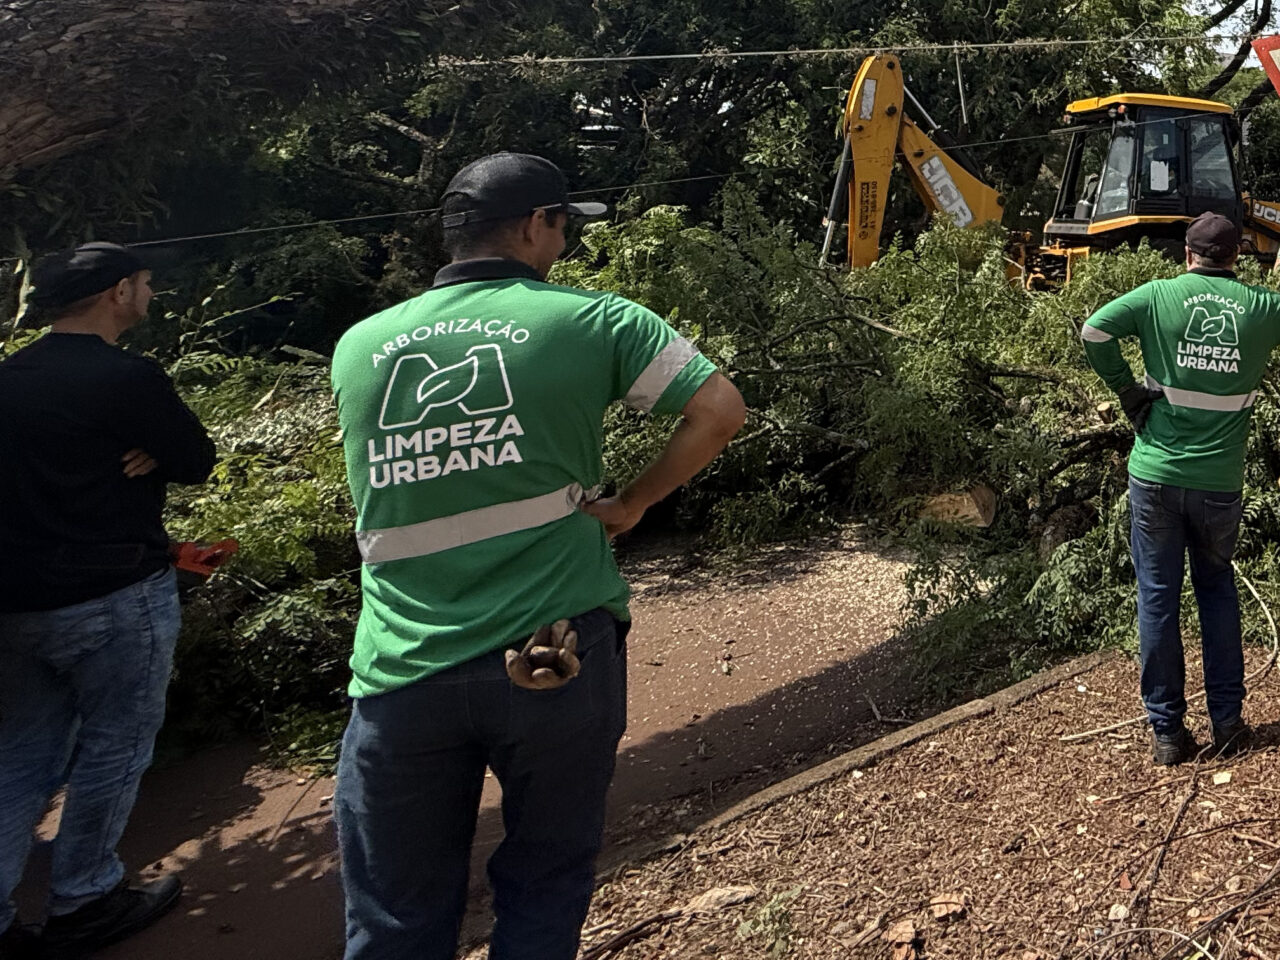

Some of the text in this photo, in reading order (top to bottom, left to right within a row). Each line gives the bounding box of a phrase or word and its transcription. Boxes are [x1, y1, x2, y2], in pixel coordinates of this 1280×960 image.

[920, 155, 973, 228] JCB
[1183, 293, 1246, 315] ARBORIZAÇÃO
[372, 318, 530, 368] ARBORIZAÇÃO
[1176, 355, 1239, 373] URBANA
[1177, 341, 1241, 361] LIMPEZA
[367, 414, 525, 463] LIMPEZA
[369, 441, 524, 489] URBANA
